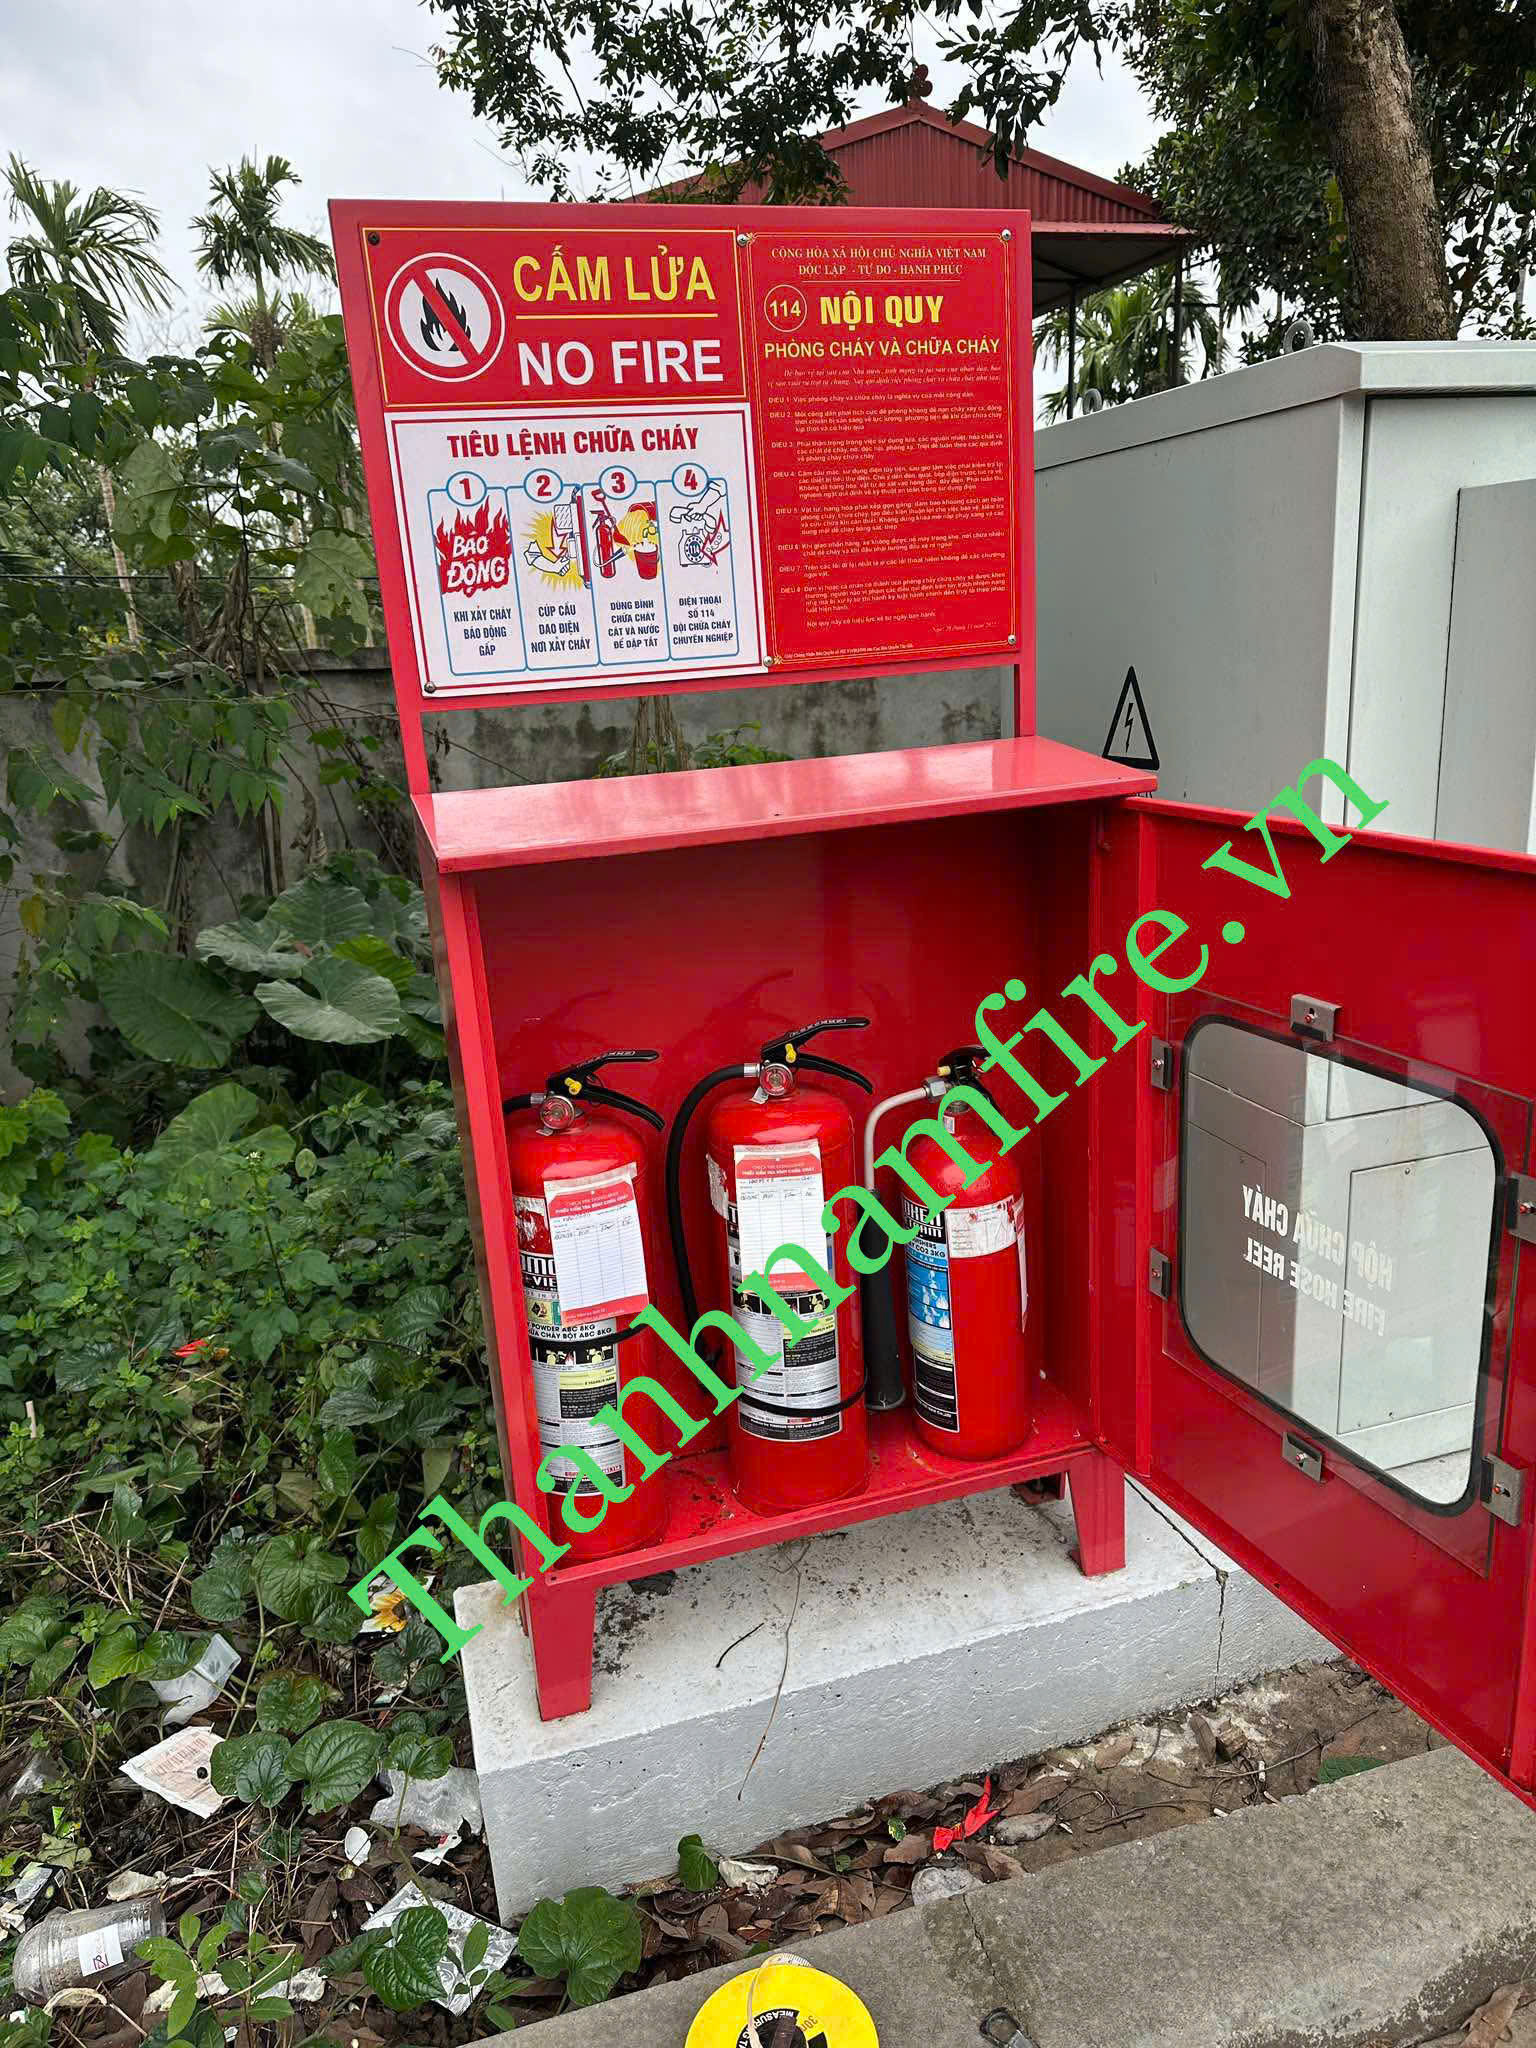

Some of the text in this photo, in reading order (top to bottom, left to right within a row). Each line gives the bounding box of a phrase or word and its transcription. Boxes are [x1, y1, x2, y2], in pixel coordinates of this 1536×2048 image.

[963, 247, 987, 258] NAM
[513, 244, 716, 301] CẤM LỬA
[876, 265, 891, 275] DO
[769, 300, 800, 318] 114
[820, 290, 944, 331] NỘI QUY
[765, 333, 1000, 359] PHÒNG CHÁY VÀ CHỮA CHÁY
[517, 339, 724, 386] NO FIRE
[447, 424, 699, 460] TIÊU LỆNH CHỮA CHÁY
[536, 475, 552, 497] 2
[611, 472, 626, 494] 3
[683, 469, 698, 491] 4
[459, 478, 472, 500] 1
[447, 557, 506, 593] ĐỘNG
[679, 596, 698, 607] ĐIỆN
[454, 611, 468, 622] KHI
[490, 606, 512, 621] CHÁY
[538, 604, 556, 617] CÚP
[635, 611, 656, 622] CHÁY
[701, 609, 715, 618] 114
[539, 620, 580, 635] DAO ĐIỆN
[625, 625, 636, 635] VÀ
[638, 623, 660, 634] NƯỚC
[711, 619, 731, 630] CHÁY
[464, 625, 507, 640] BÁO ĐỘNG
[673, 632, 734, 645] CHUYÊN NGHIỆP
[531, 641, 546, 653] NƠI
[568, 637, 591, 651] CHÁY
[532, 1323, 560, 1332] POWDER
[579, 1323, 596, 1331] 8KG
[579, 1330, 595, 1338] ABC
[597, 1327, 612, 1336] 8KG
